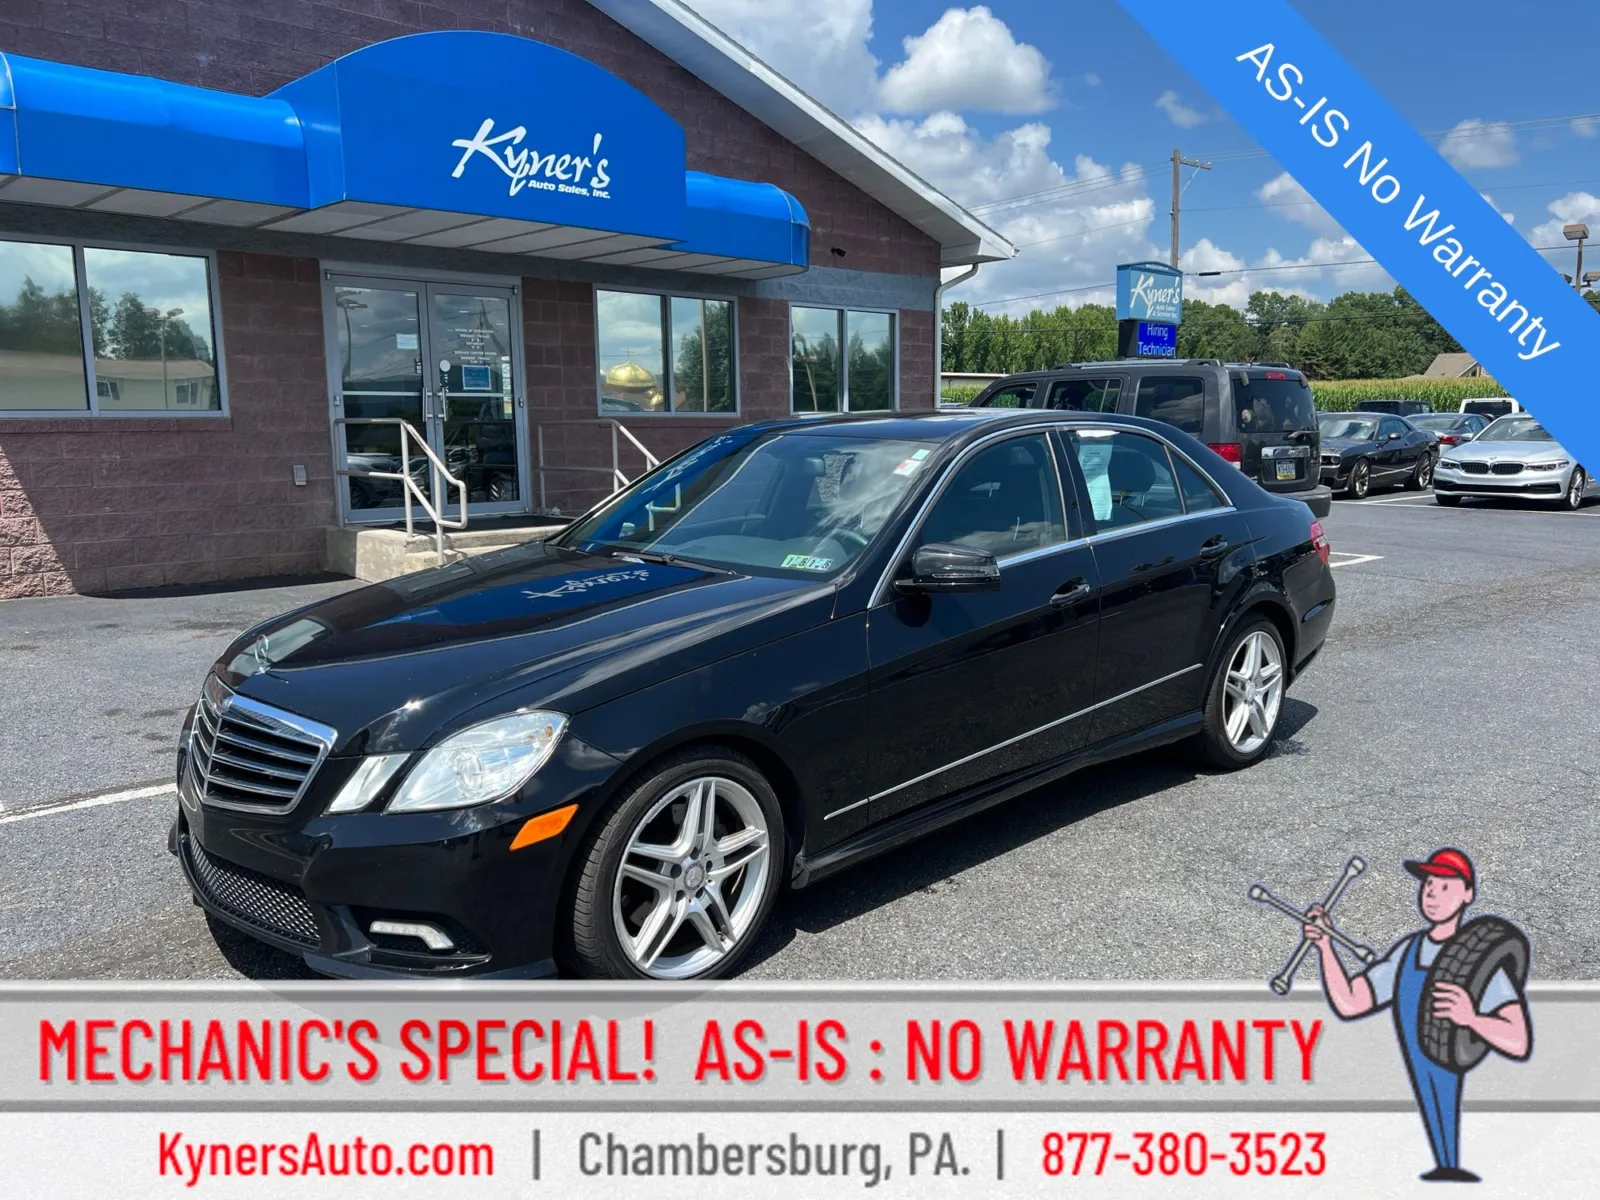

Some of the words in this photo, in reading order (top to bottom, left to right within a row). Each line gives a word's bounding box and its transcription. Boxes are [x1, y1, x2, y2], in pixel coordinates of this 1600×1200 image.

[451, 118, 610, 196] Kyner's
[528, 180, 555, 191] Auto
[557, 184, 590, 197] Sales,
[592, 189, 611, 198] Inc.
[1130, 274, 1180, 319] Kyner's
[1147, 324, 1168, 340] Hiring
